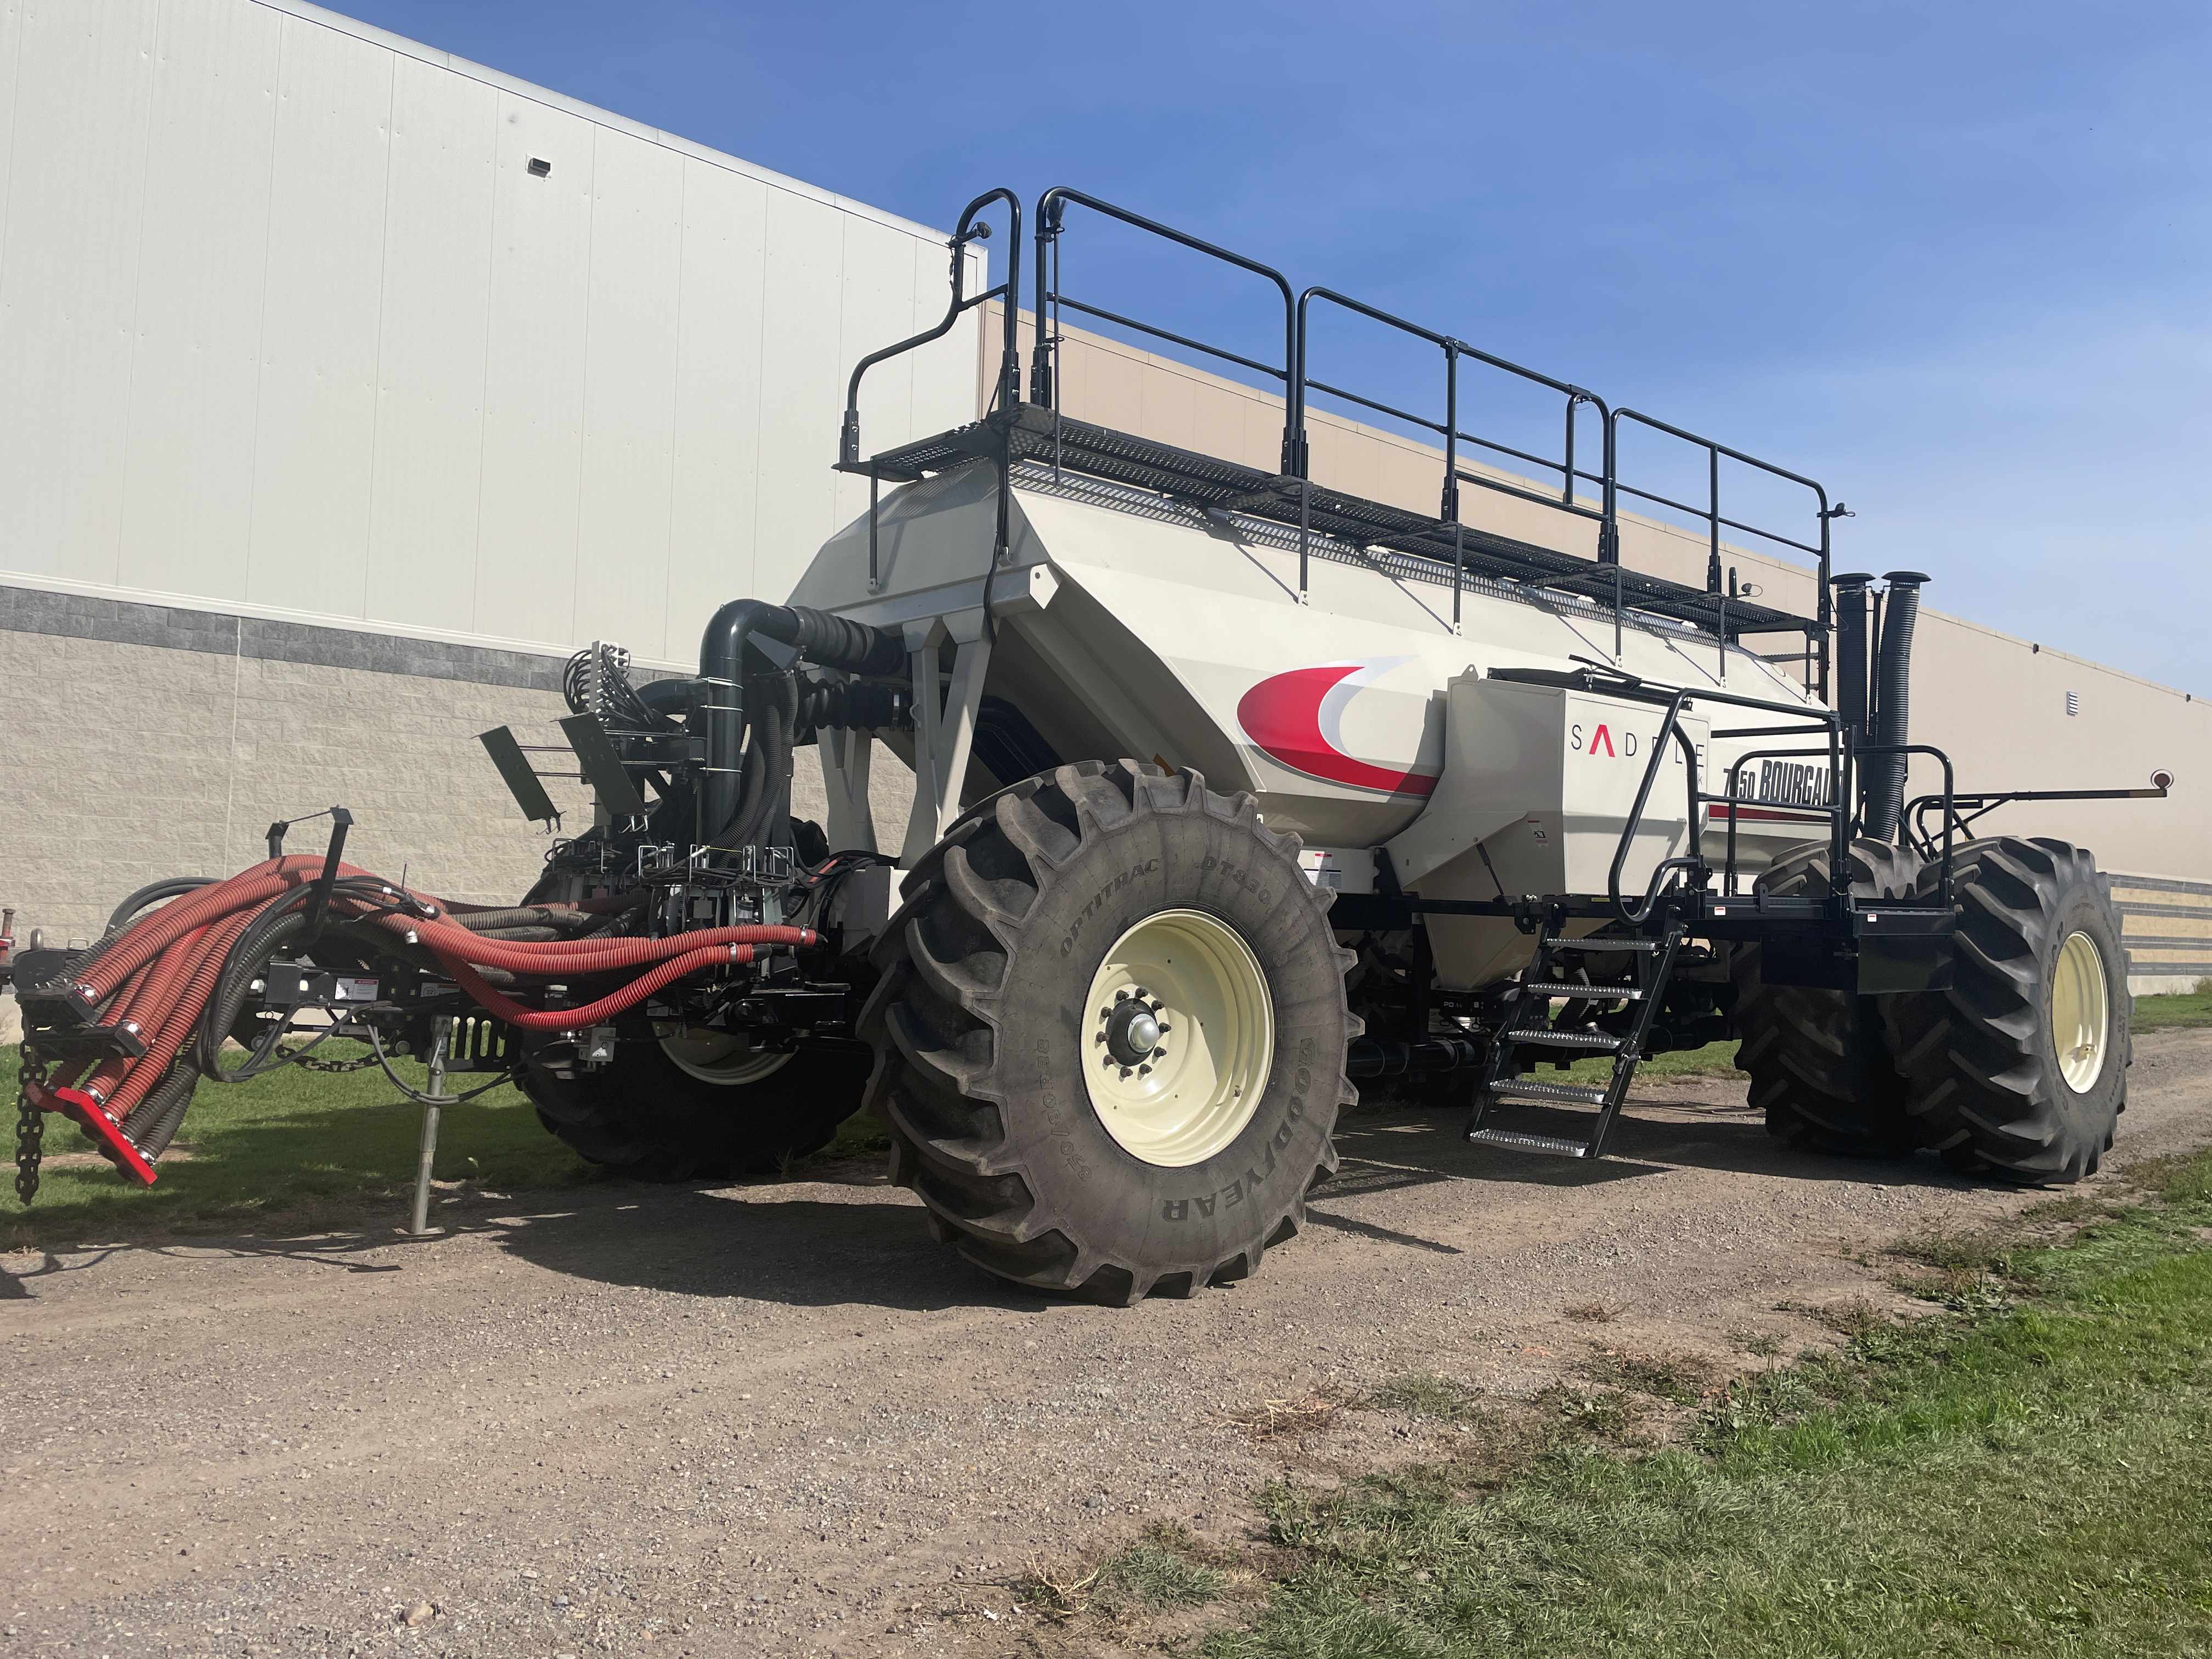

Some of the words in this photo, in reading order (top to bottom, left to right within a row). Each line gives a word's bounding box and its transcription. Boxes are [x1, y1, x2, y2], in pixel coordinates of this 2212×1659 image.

[1571, 724, 1705, 768] SADLE
[1723, 768, 1756, 799] 750
[1759, 759, 1844, 805] BOURGAU
[1060, 858, 1159, 958] OPTITRAC
[1161, 1036, 1316, 1222] GOODYEAR
